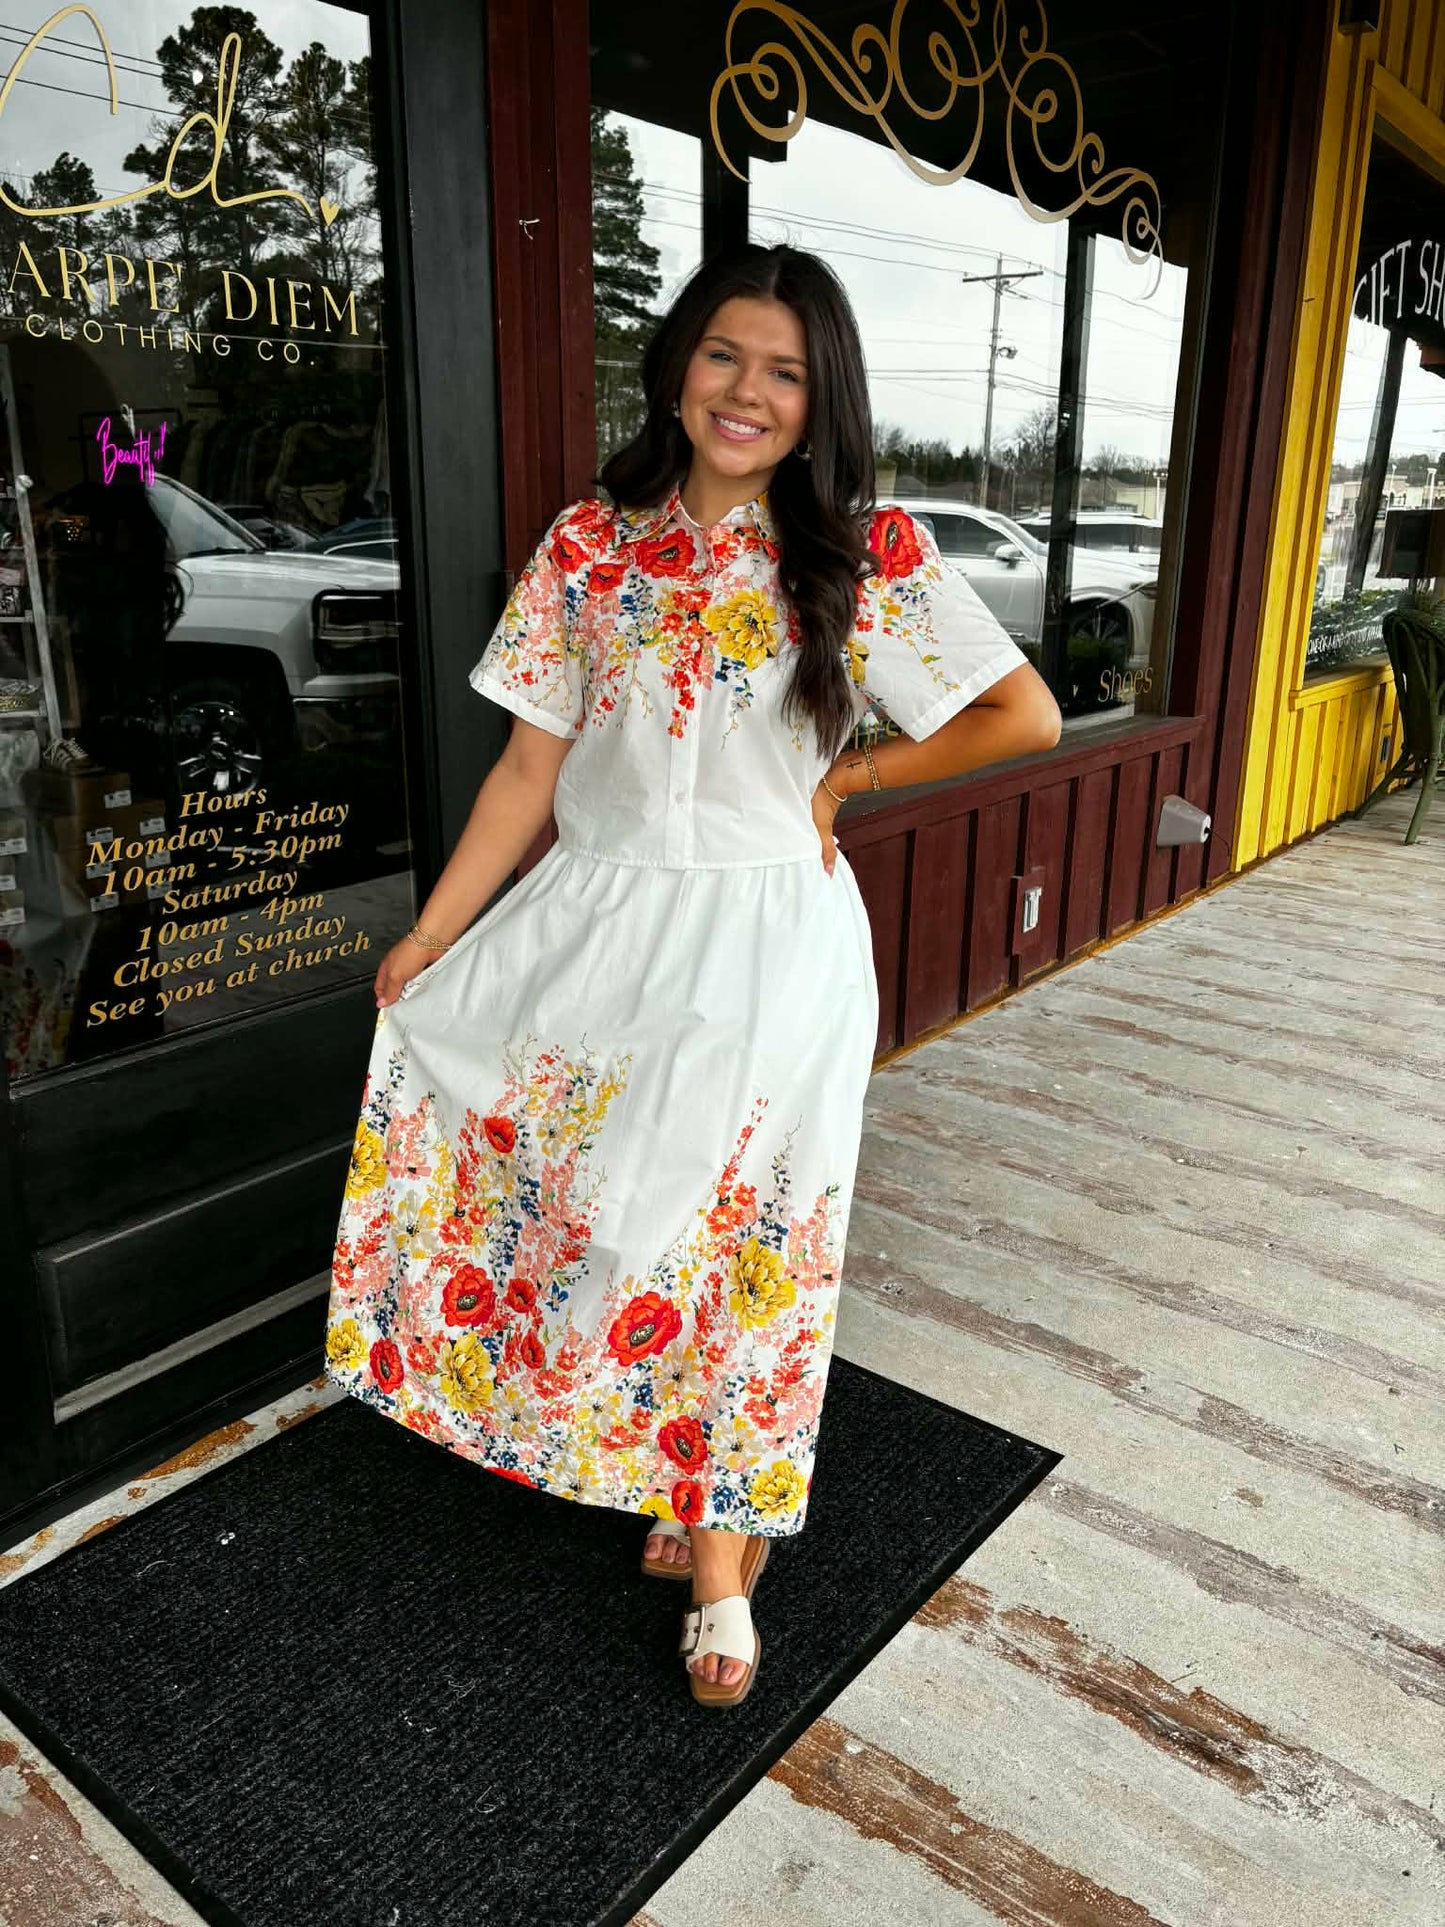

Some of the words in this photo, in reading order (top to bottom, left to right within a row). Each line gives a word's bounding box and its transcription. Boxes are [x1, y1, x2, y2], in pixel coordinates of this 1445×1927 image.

[7, 240, 183, 314] ARPE
[221, 269, 360, 337] DIEM
[1414, 239, 1445, 329] SH
[25, 314, 232, 357] CLOTHING
[257, 340, 316, 366] CO.
[86, 823, 224, 867] Monday
[252, 801, 350, 836] Friday
[178, 787, 267, 818] Hours
[100, 862, 196, 896] 10am
[227, 832, 343, 872] 5:30pm
[162, 869, 299, 915] Saturday
[113, 938, 224, 988] Closed
[235, 914, 346, 958] Sunday
[136, 914, 230, 952] 10am
[259, 893, 325, 926] 4pm
[86, 996, 146, 1028] See
[154, 976, 217, 1017] you
[226, 962, 259, 989] at
[268, 930, 371, 977] church
